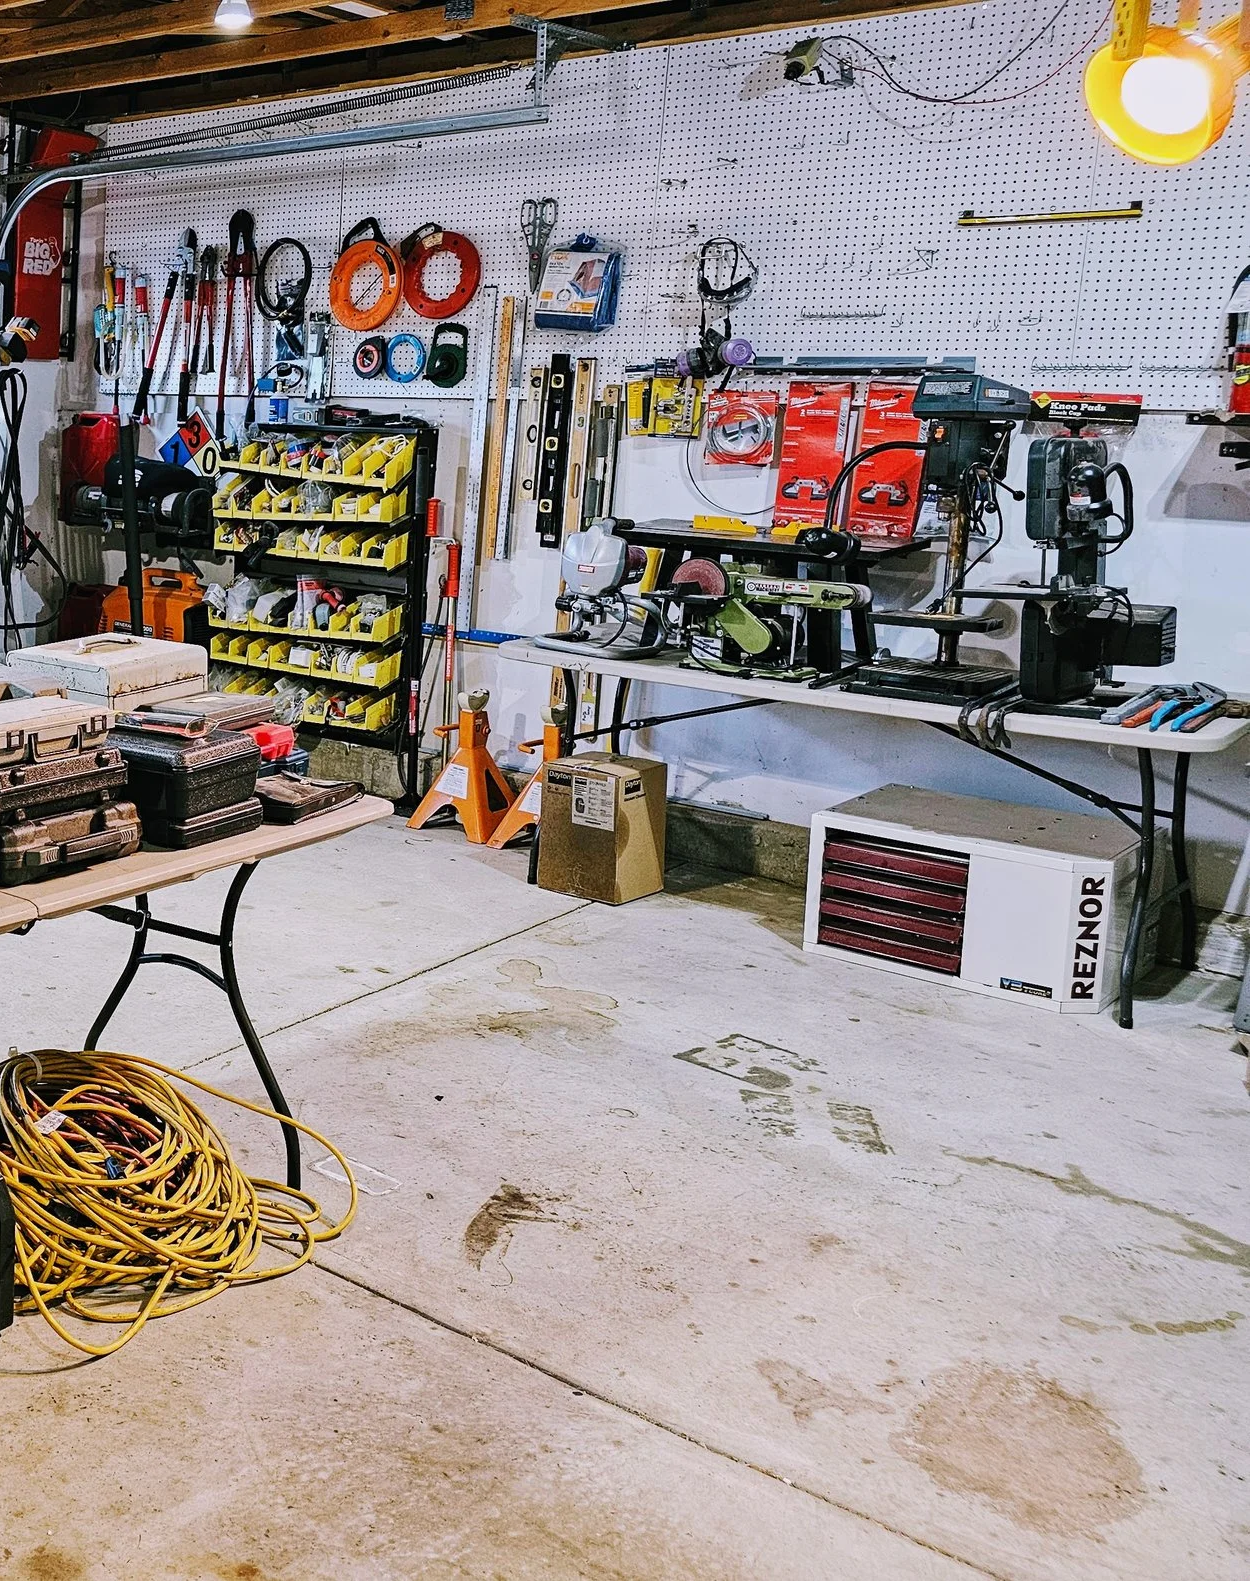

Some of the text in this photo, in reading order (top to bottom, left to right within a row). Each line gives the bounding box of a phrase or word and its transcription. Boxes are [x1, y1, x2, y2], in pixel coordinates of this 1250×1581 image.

[23, 241, 51, 260] BIG
[22, 258, 53, 276] RED
[1049, 402, 1107, 412] Knee Pads
[188, 421, 201, 448] 3
[170, 441, 180, 464] 1
[202, 447, 216, 474] 0
[548, 770, 572, 781] Dayton
[625, 779, 641, 788] Dayton
[1070, 876, 1106, 1000] REZNOR
